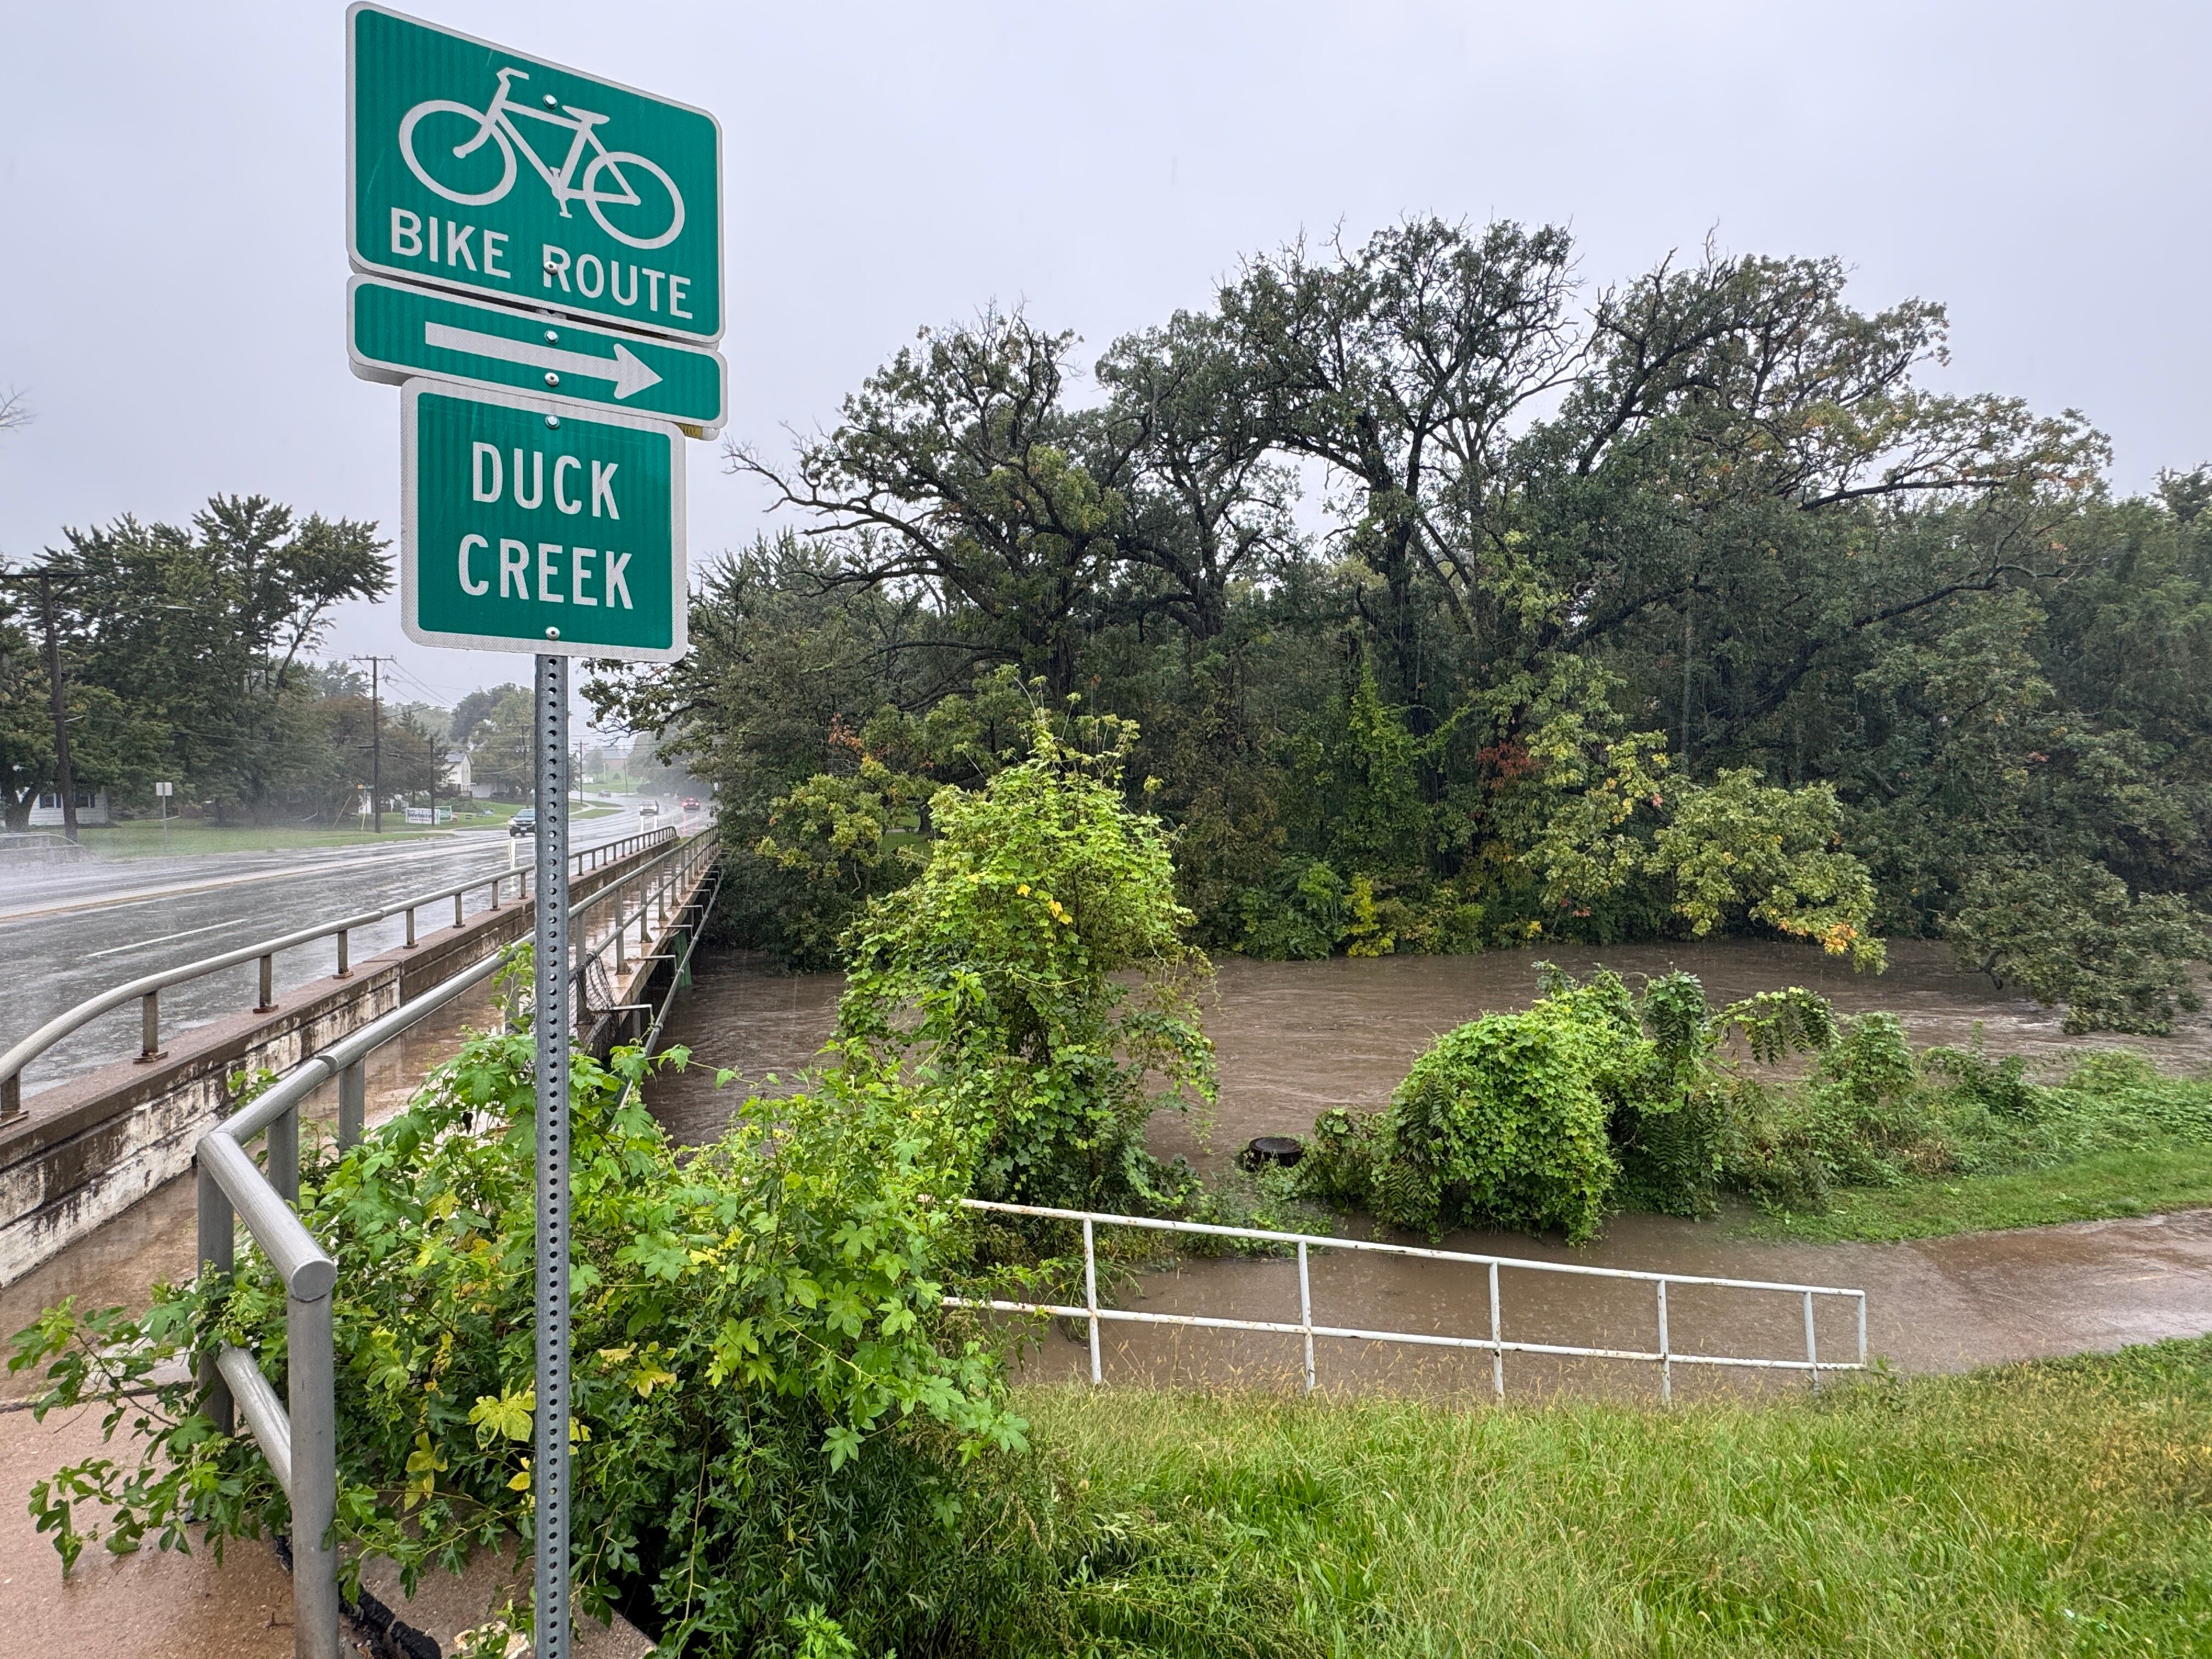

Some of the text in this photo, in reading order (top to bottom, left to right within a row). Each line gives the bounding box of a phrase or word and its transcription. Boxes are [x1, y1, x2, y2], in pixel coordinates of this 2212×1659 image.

[391, 207, 693, 319] BIKE ROUTE
[473, 441, 620, 520] DUCK
[459, 534, 633, 610] CREEK
